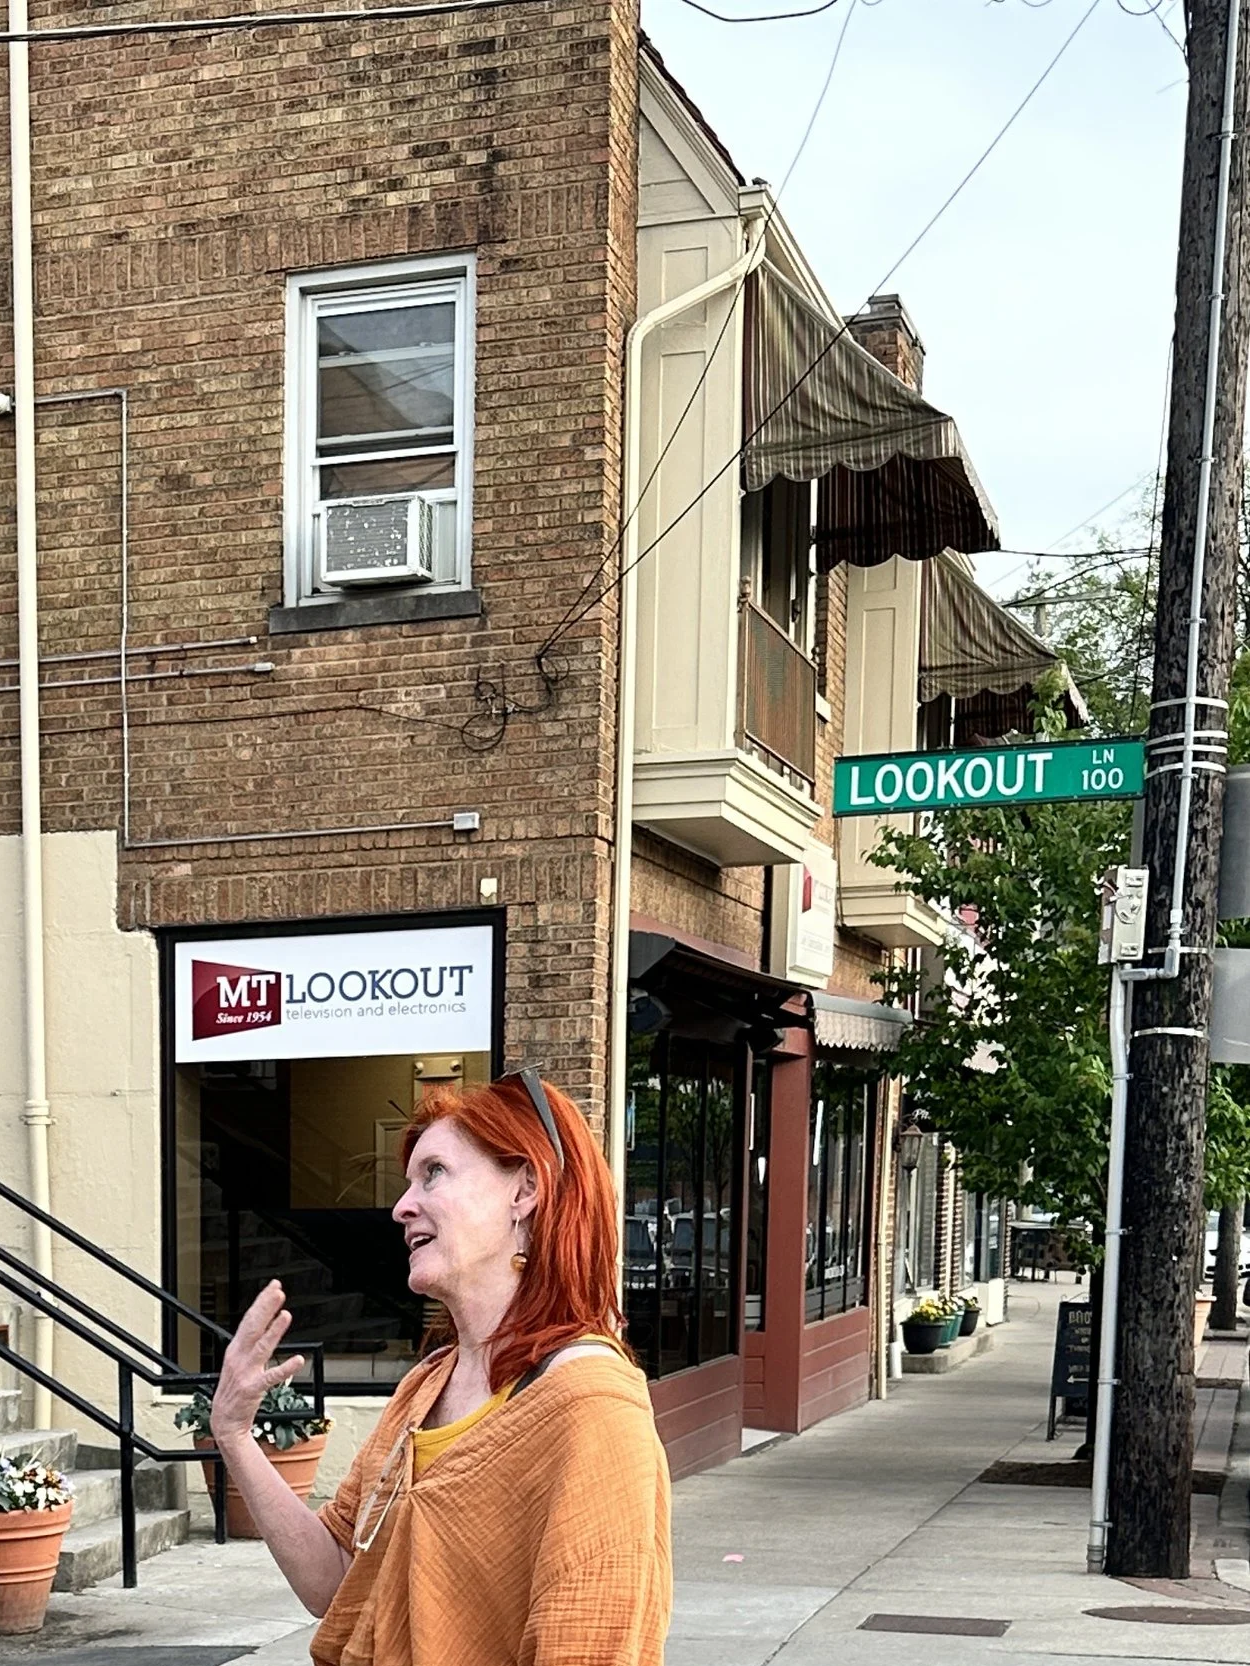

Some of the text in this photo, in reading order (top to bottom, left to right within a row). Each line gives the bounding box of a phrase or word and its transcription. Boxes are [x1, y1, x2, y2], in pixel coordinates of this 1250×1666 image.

[850, 749, 1114, 805] LOOKOUT LN
[1082, 767, 1124, 791] 100
[216, 965, 473, 1008] MT LOOKOUT
[216, 1010, 272, 1024] Since 1954
[286, 1001, 466, 1020] television and electronics
